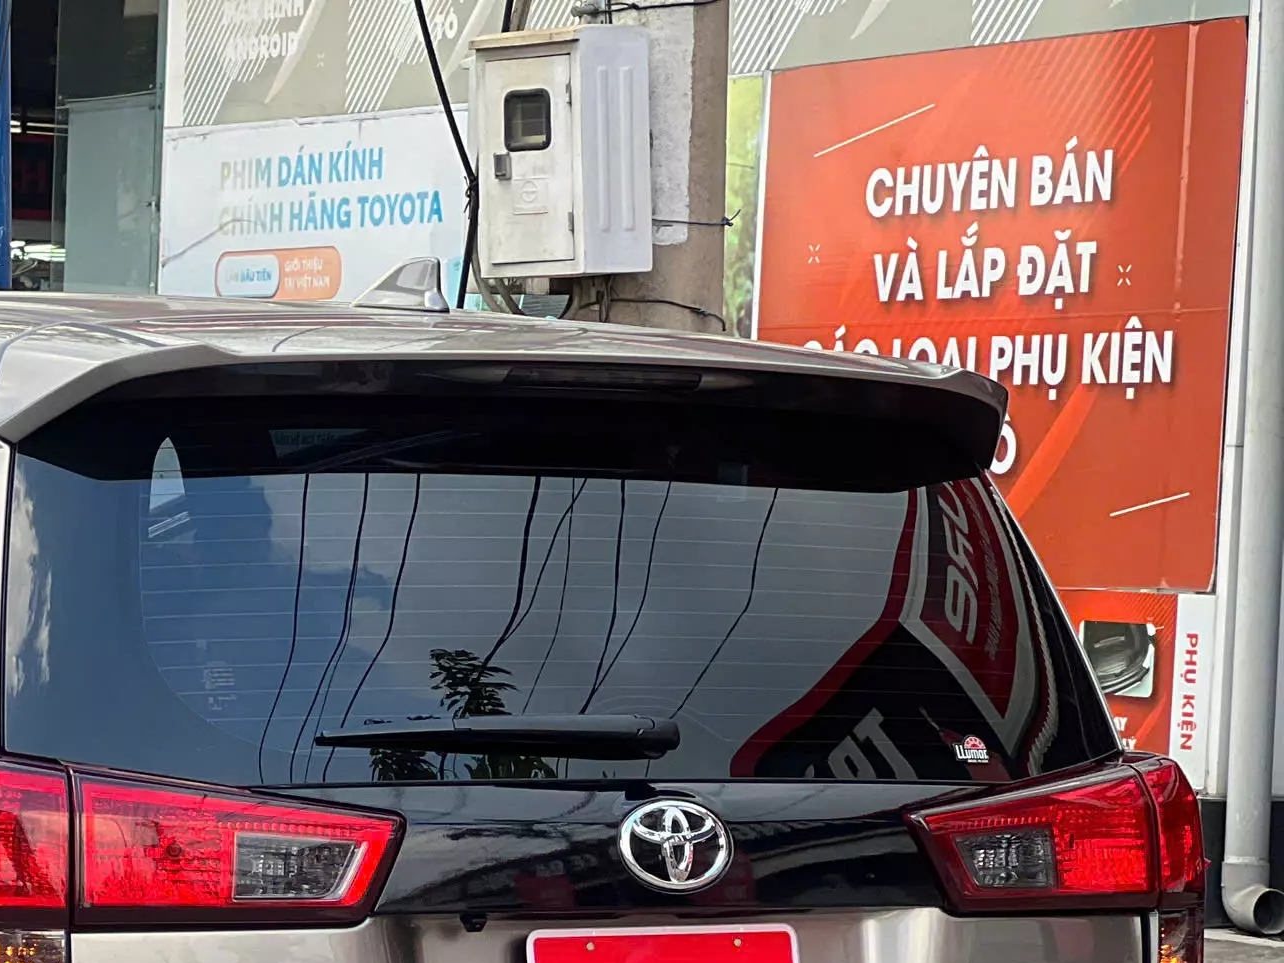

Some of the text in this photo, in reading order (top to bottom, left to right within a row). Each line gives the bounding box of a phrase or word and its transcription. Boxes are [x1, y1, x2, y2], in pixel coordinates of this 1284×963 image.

[220, 141, 384, 191] PHIM DÁN KÍNH
[865, 136, 1113, 219] CHUYÊN BÁN
[219, 190, 443, 236] CHÍNH HÃNG TOYOTA
[874, 222, 1098, 309] VÀ LẮP ĐẶT
[989, 334, 1067, 400] PHỤ
[1081, 316, 1174, 399] KIỆN
[1177, 633, 1199, 750] PHỤ KIỆN
